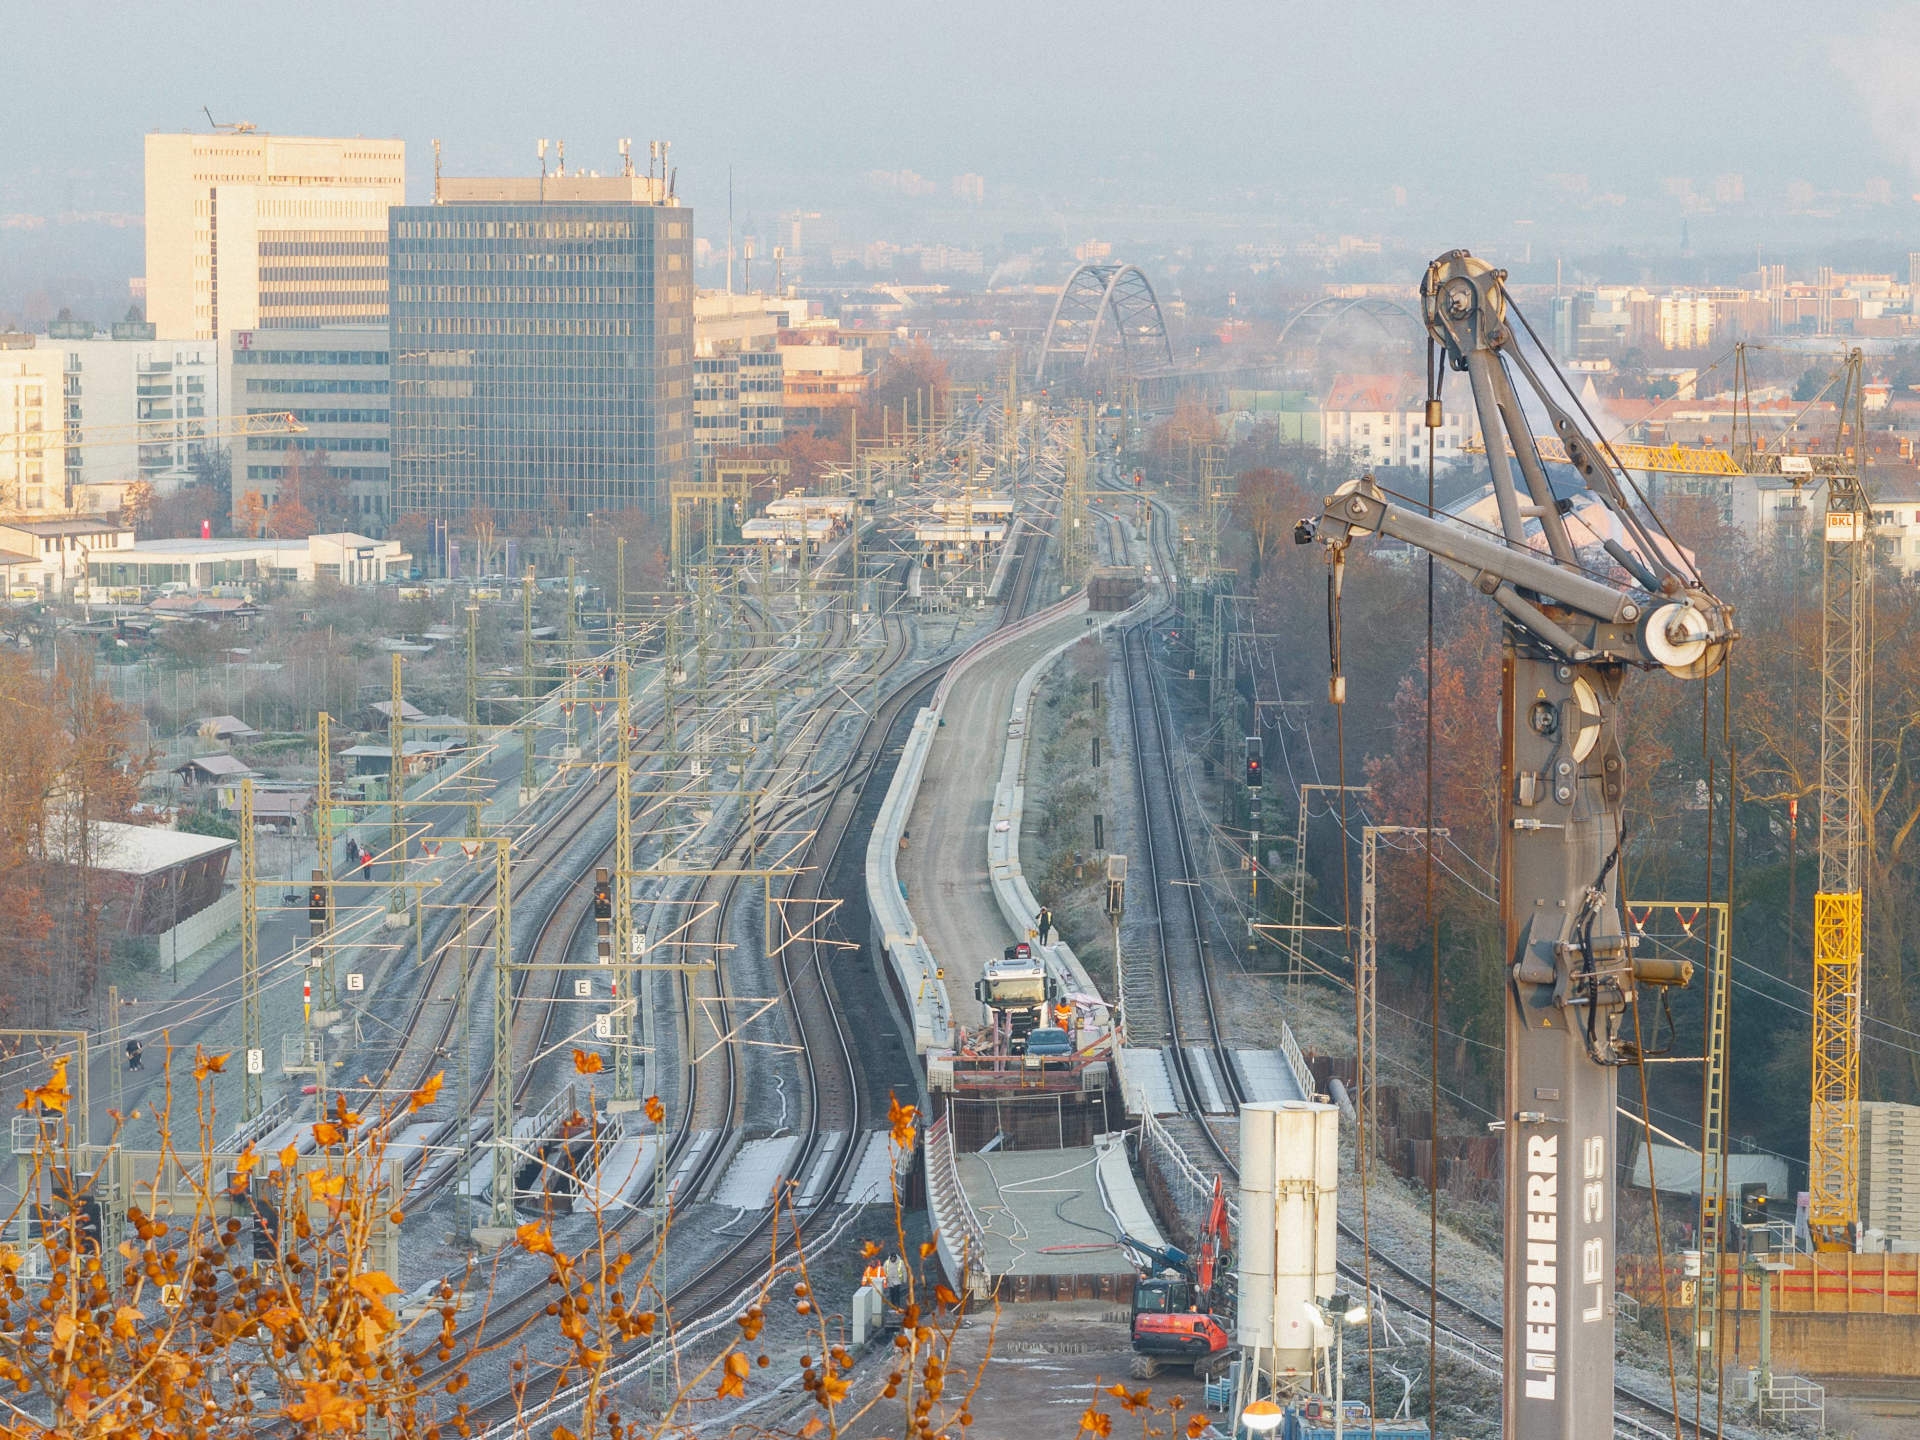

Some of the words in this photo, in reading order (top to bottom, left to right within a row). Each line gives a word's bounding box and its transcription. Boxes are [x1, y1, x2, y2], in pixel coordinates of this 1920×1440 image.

[1832, 517, 1852, 526] BKL
[351, 976, 359, 988] E
[579, 982, 587, 994] E
[1583, 1135, 1604, 1223] 35
[1526, 1134, 1558, 1400] LIEBHERR
[1583, 1237, 1603, 1323] LB
[166, 1287, 180, 1303] A
